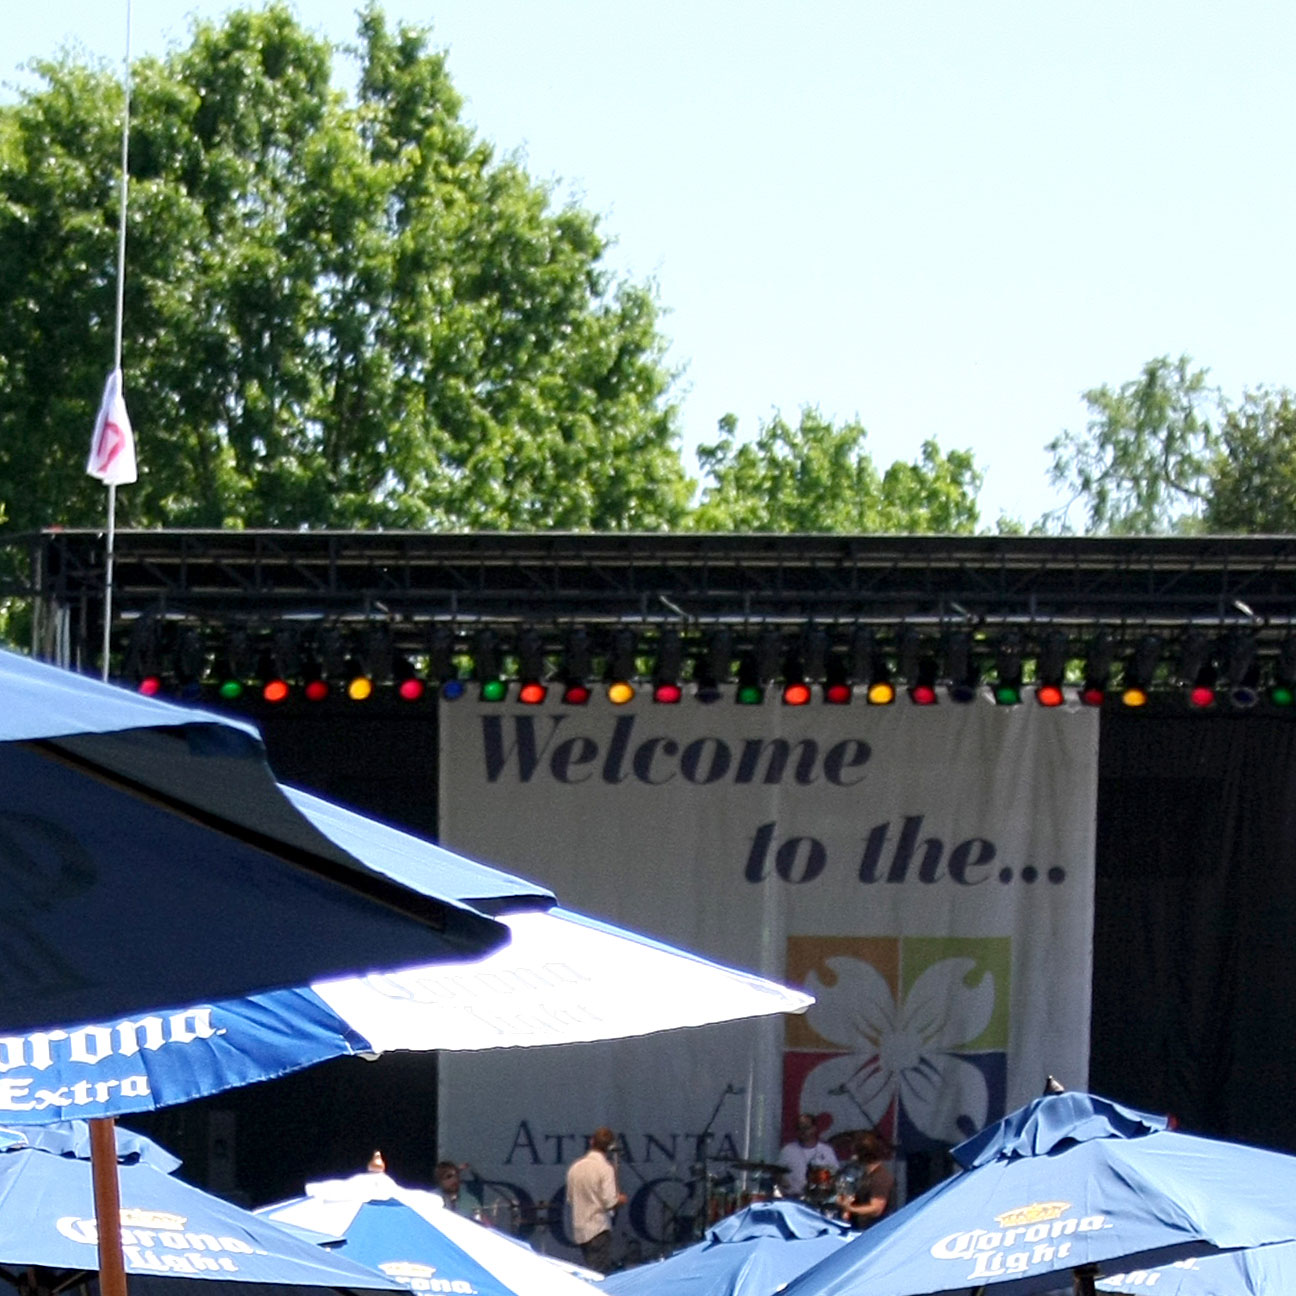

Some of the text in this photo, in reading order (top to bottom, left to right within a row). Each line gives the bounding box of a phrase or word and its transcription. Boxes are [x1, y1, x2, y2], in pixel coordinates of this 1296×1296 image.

[481, 713, 872, 786] Welcome
[744, 815, 1067, 886] to the...
[122, 1245, 239, 1274] Light
[930, 1215, 1112, 1261] Corona
[966, 1240, 1072, 1281] Light
